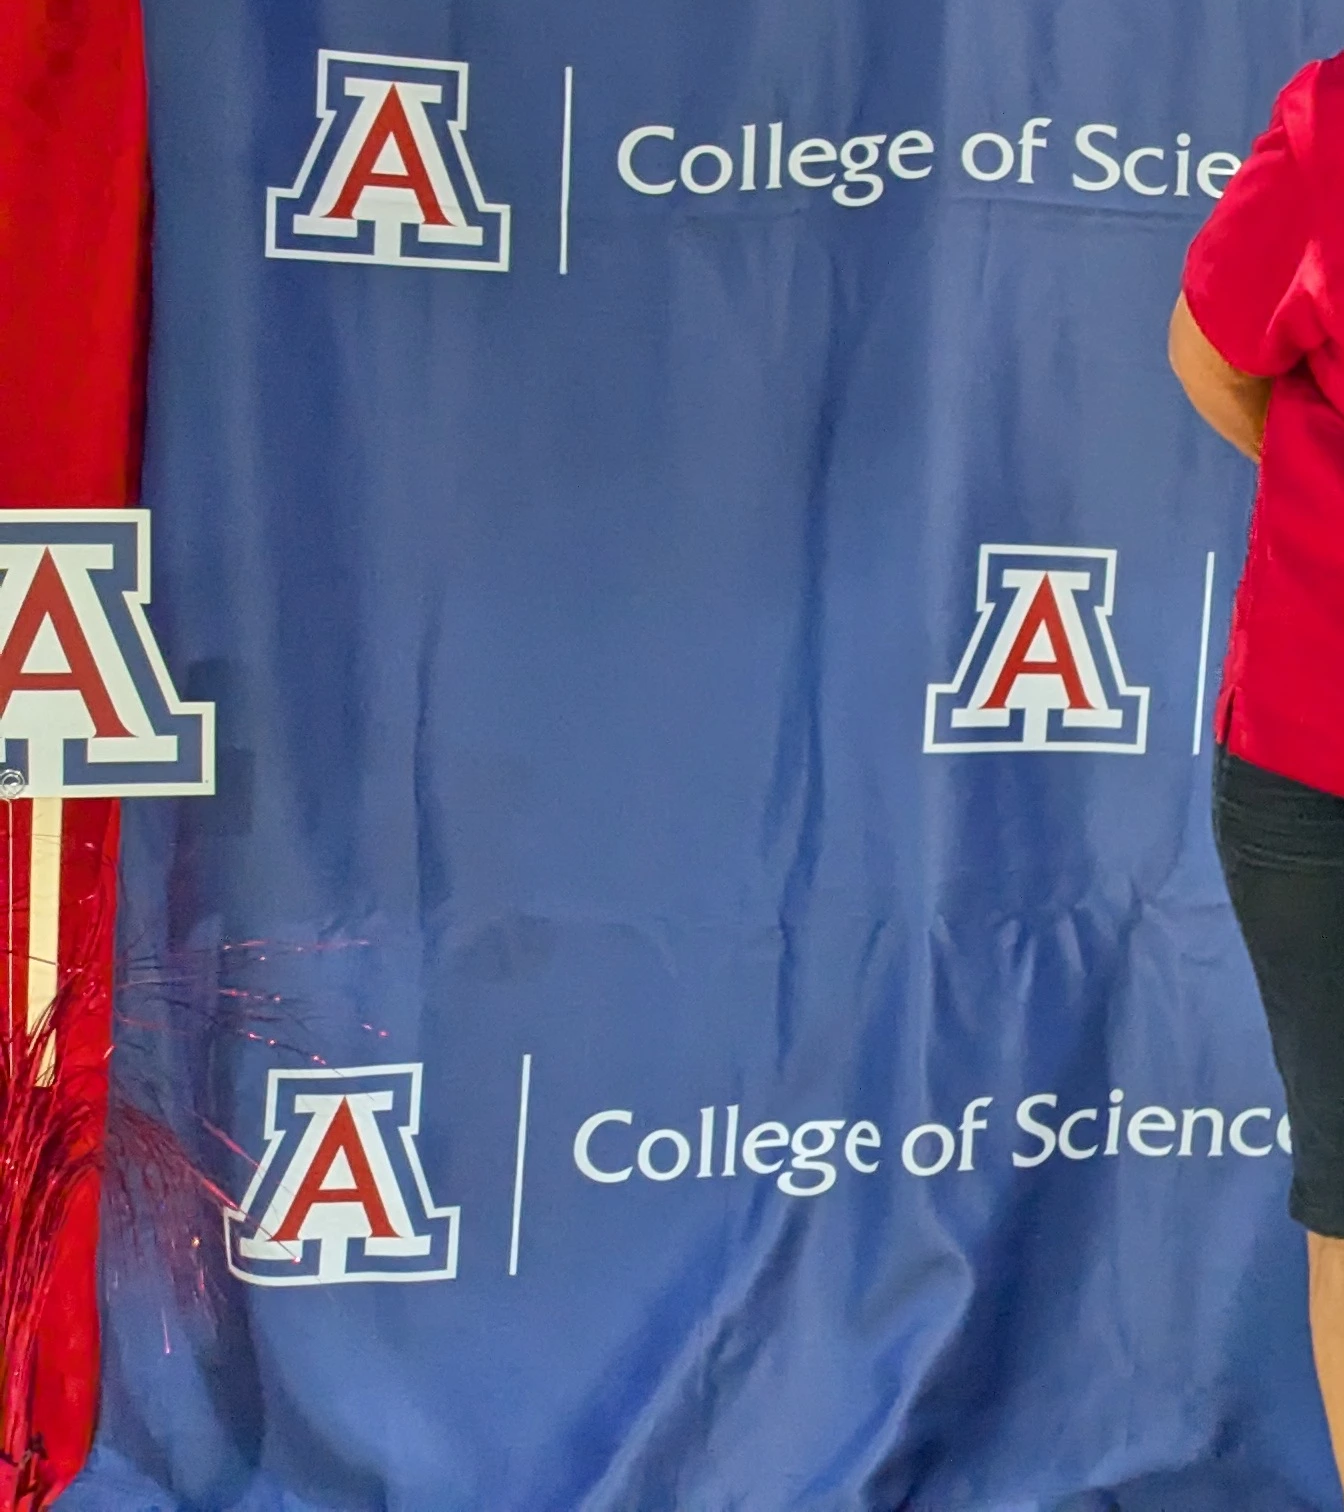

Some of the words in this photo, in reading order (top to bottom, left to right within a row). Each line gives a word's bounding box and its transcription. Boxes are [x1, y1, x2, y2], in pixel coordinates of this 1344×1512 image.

[265, 49, 511, 272] A
[617, 121, 935, 207] College
[961, 117, 1053, 184] of
[1072, 123, 1242, 200] Scie
[923, 543, 1150, 755] A
[223, 1062, 461, 1287] A
[573, 1104, 881, 1197] College
[901, 1096, 993, 1177] of
